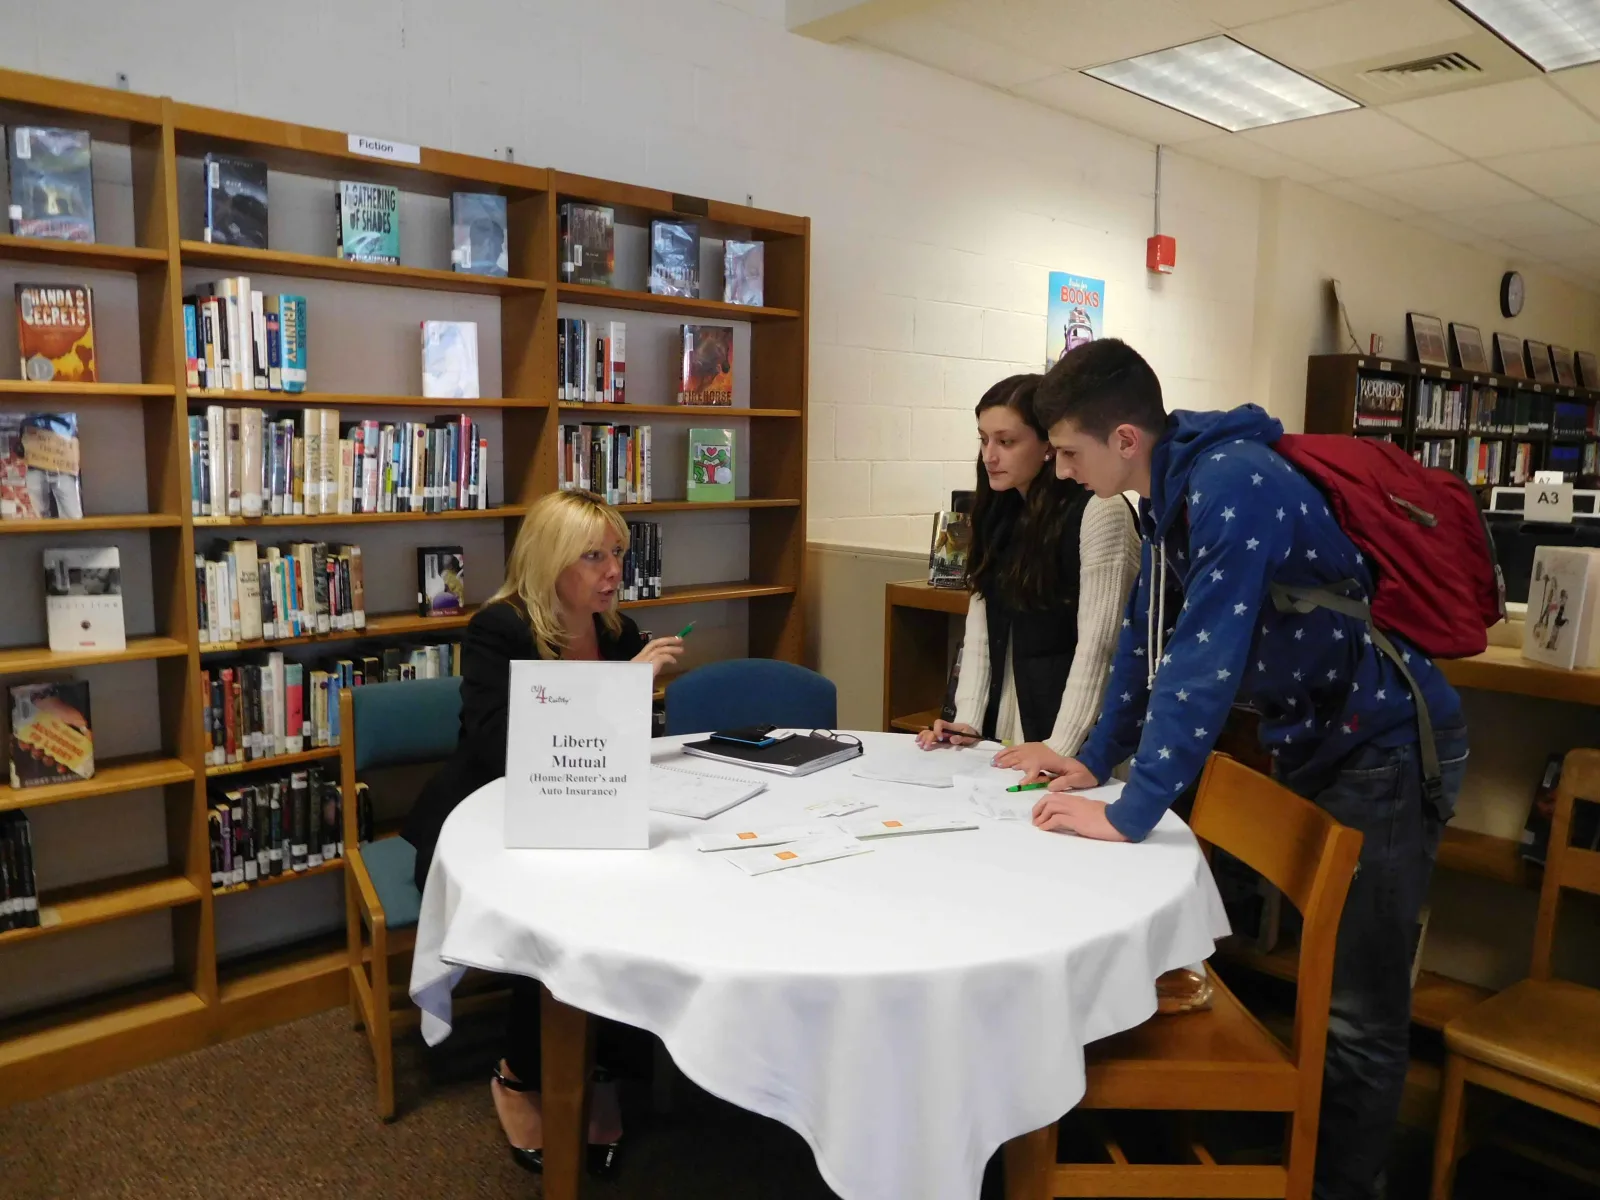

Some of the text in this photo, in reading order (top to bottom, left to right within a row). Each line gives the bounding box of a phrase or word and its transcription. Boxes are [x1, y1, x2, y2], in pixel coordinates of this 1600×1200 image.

[358, 139, 394, 153] Fiction
[352, 187, 396, 212] GATHERING
[349, 211, 391, 234] OF SHADES
[1060, 285, 1099, 307] BOOKS
[284, 301, 296, 363] TRINITY
[1386, 379, 1405, 399] BOOK
[1537, 491, 1560, 505] A3
[552, 735, 607, 751] Liberty
[552, 755, 606, 768] Mutual
[529, 773, 627, 784] (Home/Renter's and
[539, 787, 617, 797] Auto Insurance)
